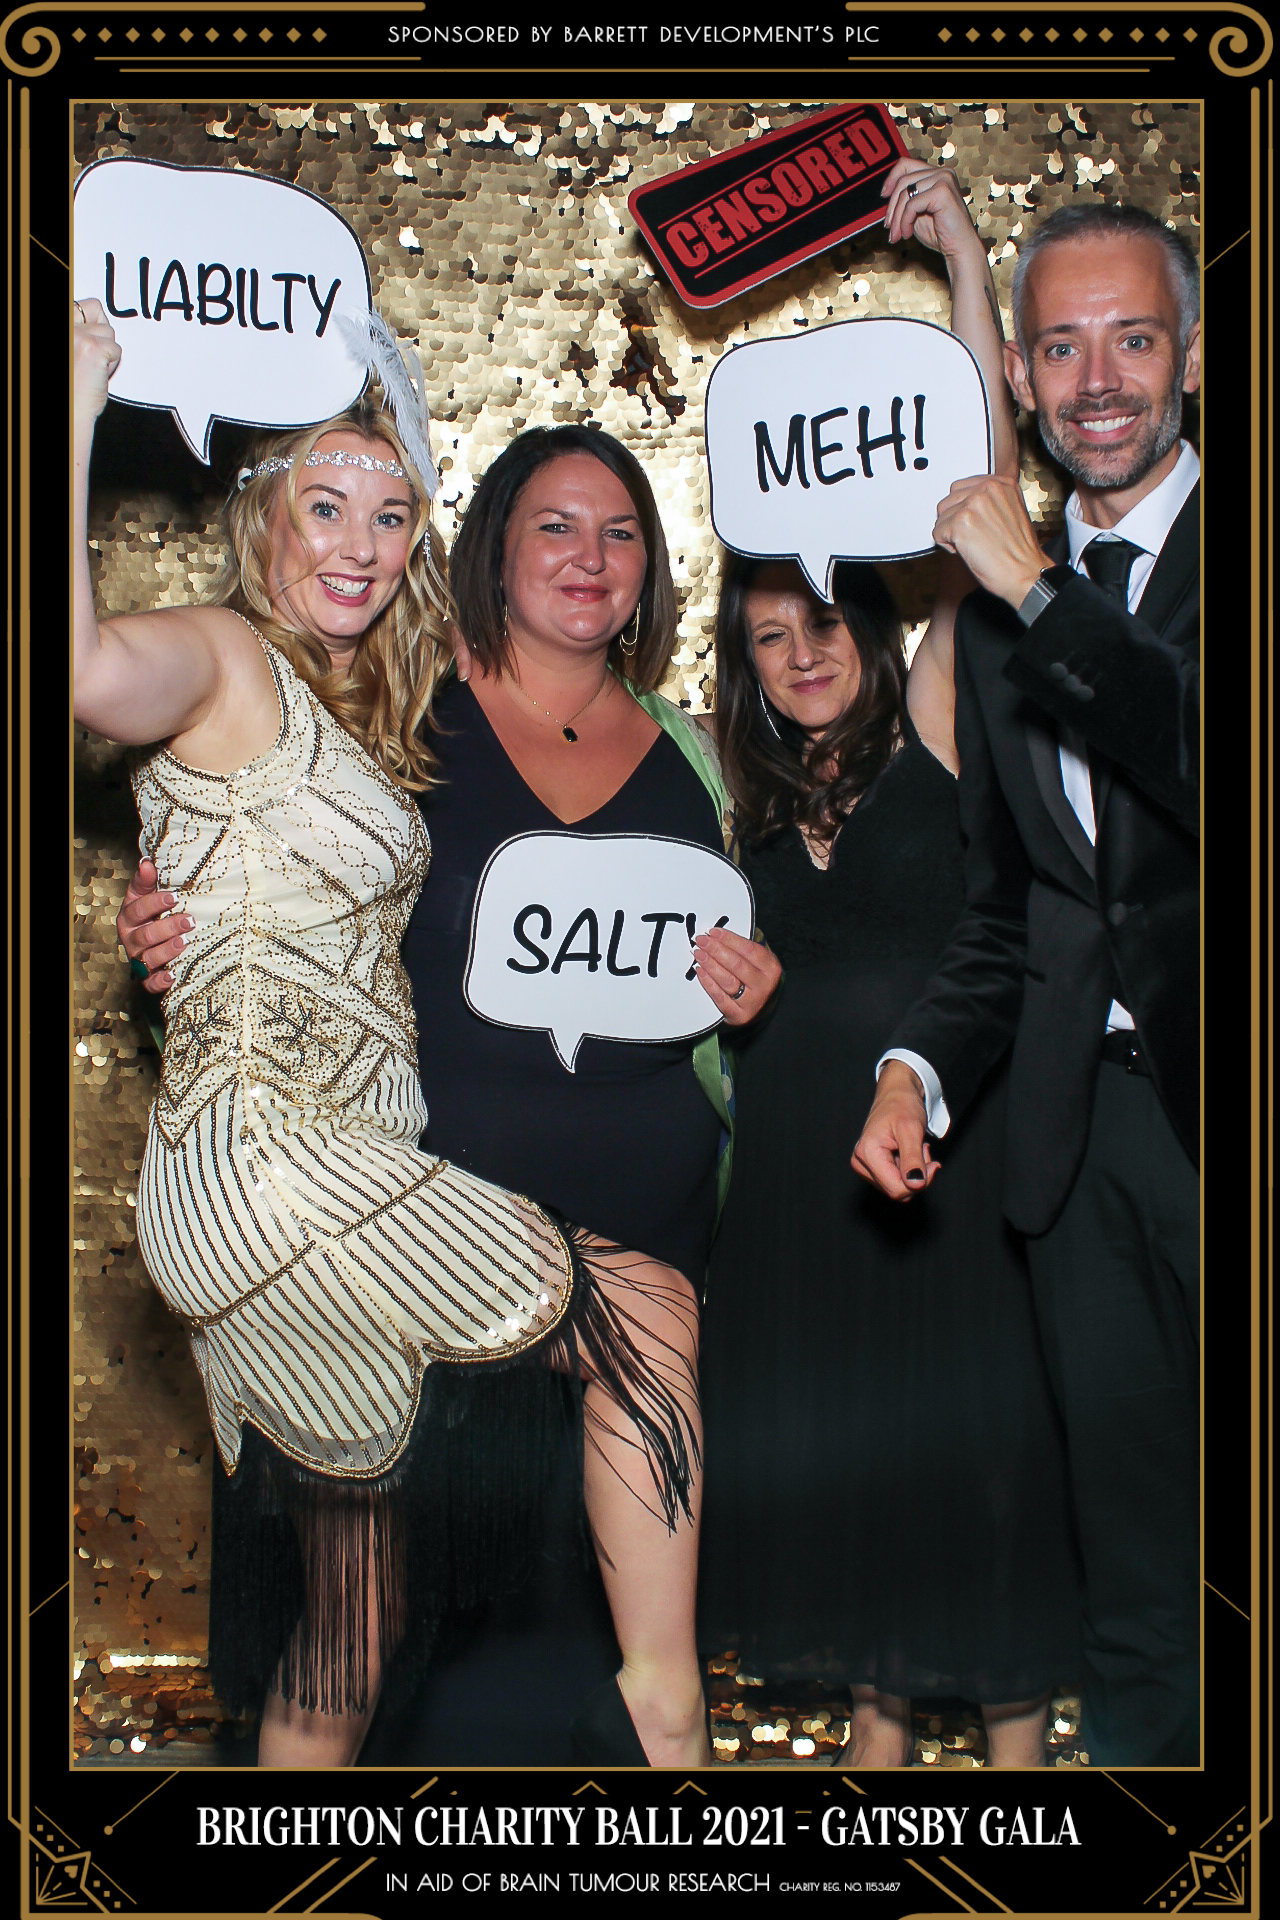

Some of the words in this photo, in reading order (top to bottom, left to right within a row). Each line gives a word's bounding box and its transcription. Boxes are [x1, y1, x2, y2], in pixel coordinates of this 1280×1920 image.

[665, 118, 891, 267] CENSORED
[105, 251, 342, 338] LIABILTY
[754, 394, 929, 493] MEH!
